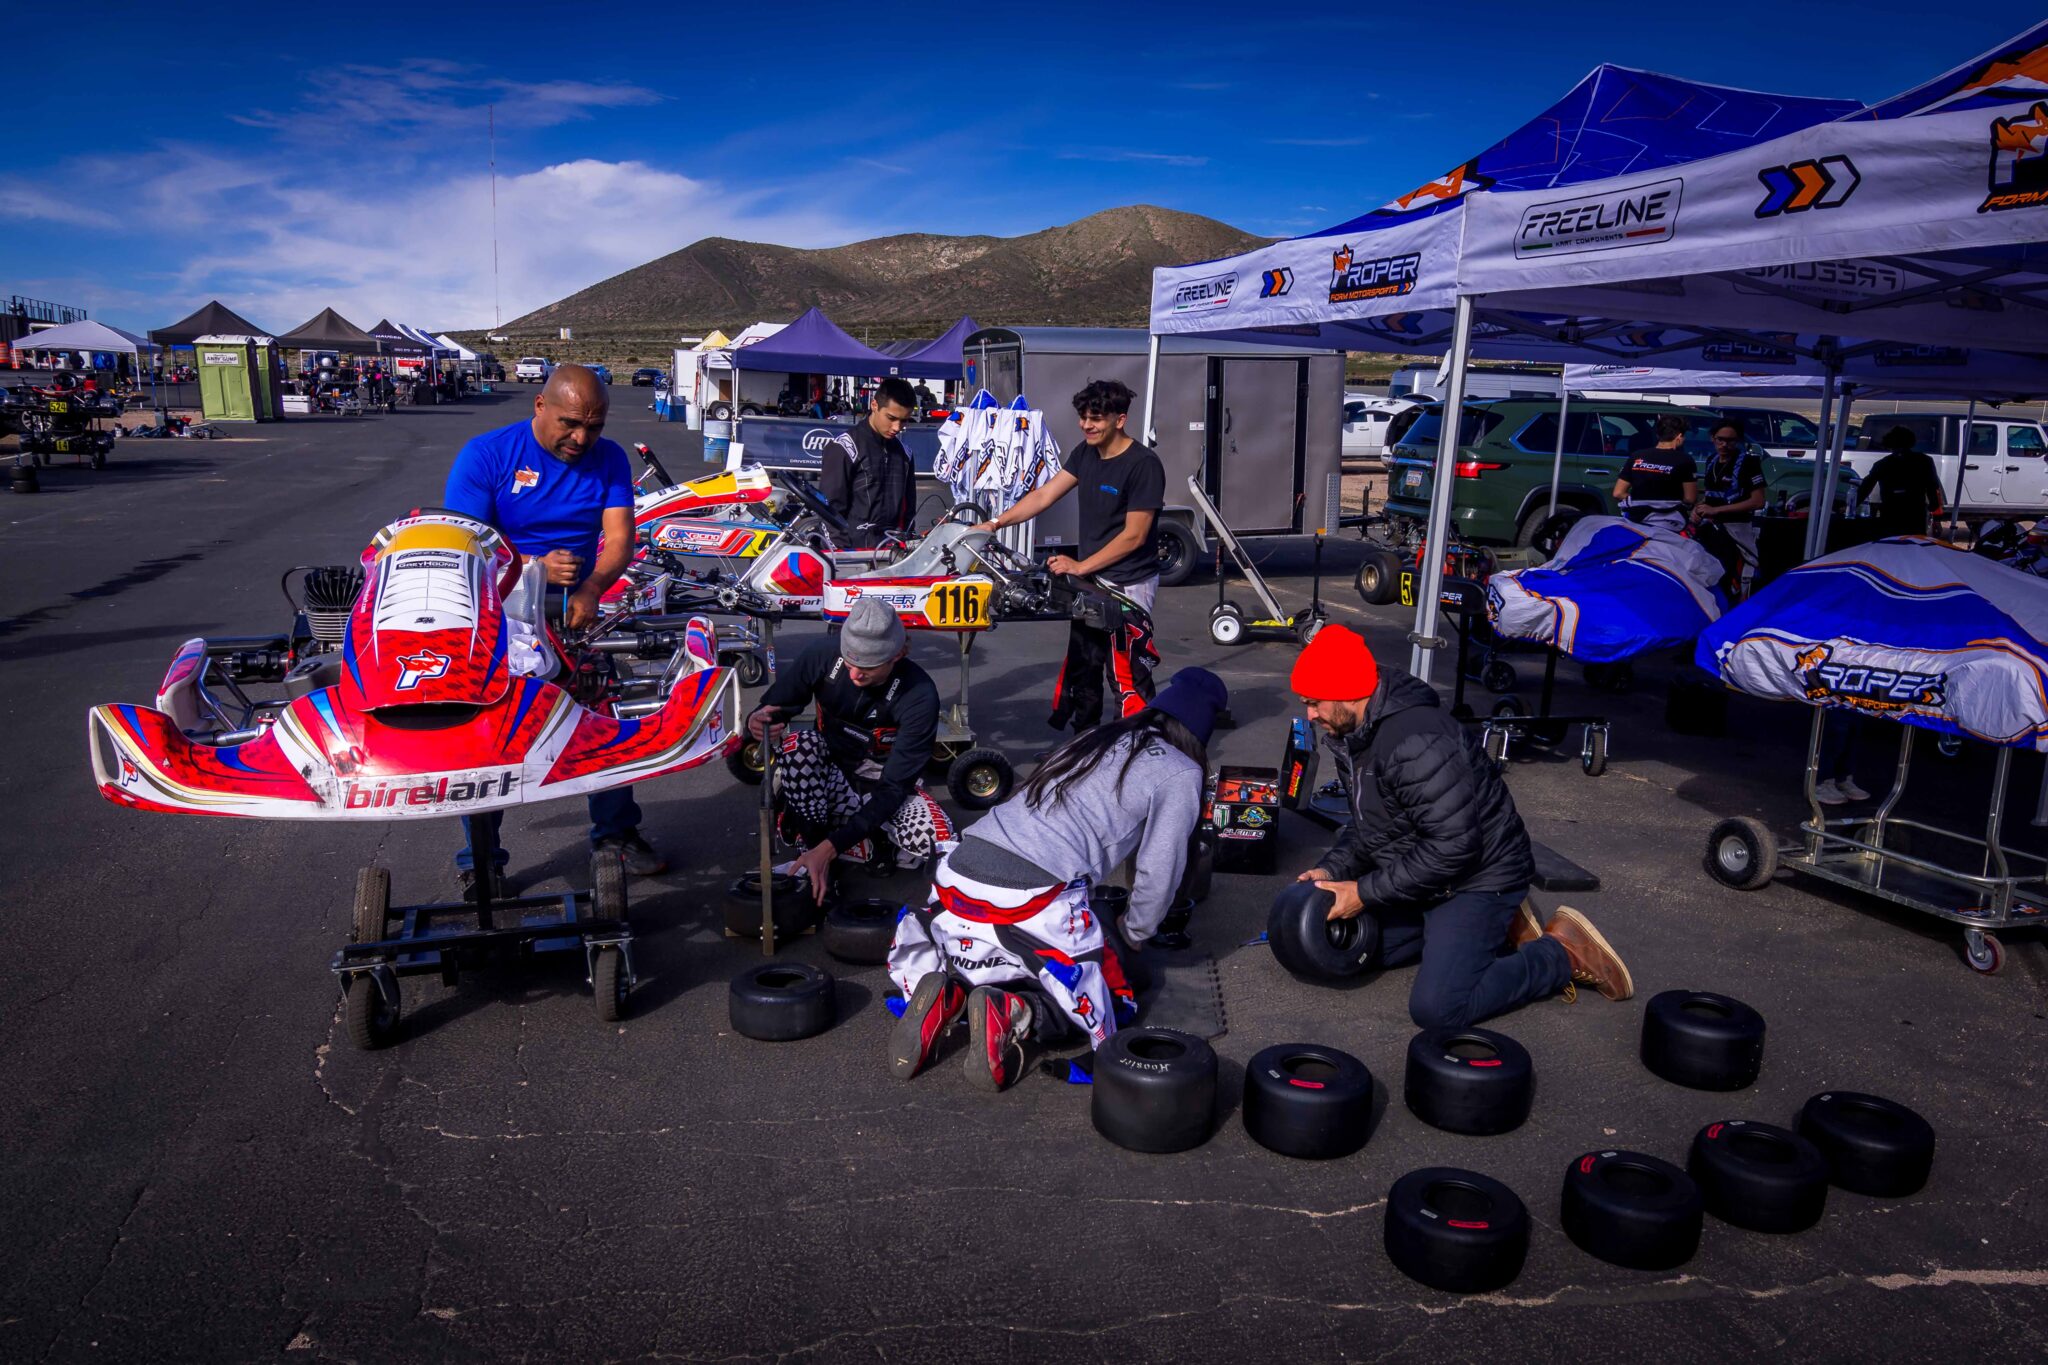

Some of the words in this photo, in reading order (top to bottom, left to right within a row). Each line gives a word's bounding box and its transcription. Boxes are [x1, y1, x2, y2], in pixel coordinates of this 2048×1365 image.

[1522, 190, 1671, 239] FREELINE
[1555, 239, 1572, 247] KART
[1575, 233, 1624, 245] COMPONENTS
[1331, 248, 1420, 288] PROPER
[1176, 278, 1235, 302] FREELINE
[1349, 285, 1398, 299] MOTORSPORTS
[50, 402, 66, 412] 524
[1633, 459, 1673, 471] PROPER
[658, 538, 702, 551] PROPER
[845, 587, 916, 604] PPER
[1403, 574, 1411, 604] 5
[1440, 592, 1463, 601] PER
[935, 585, 979, 623] 116
[344, 771, 520, 810] birelart
